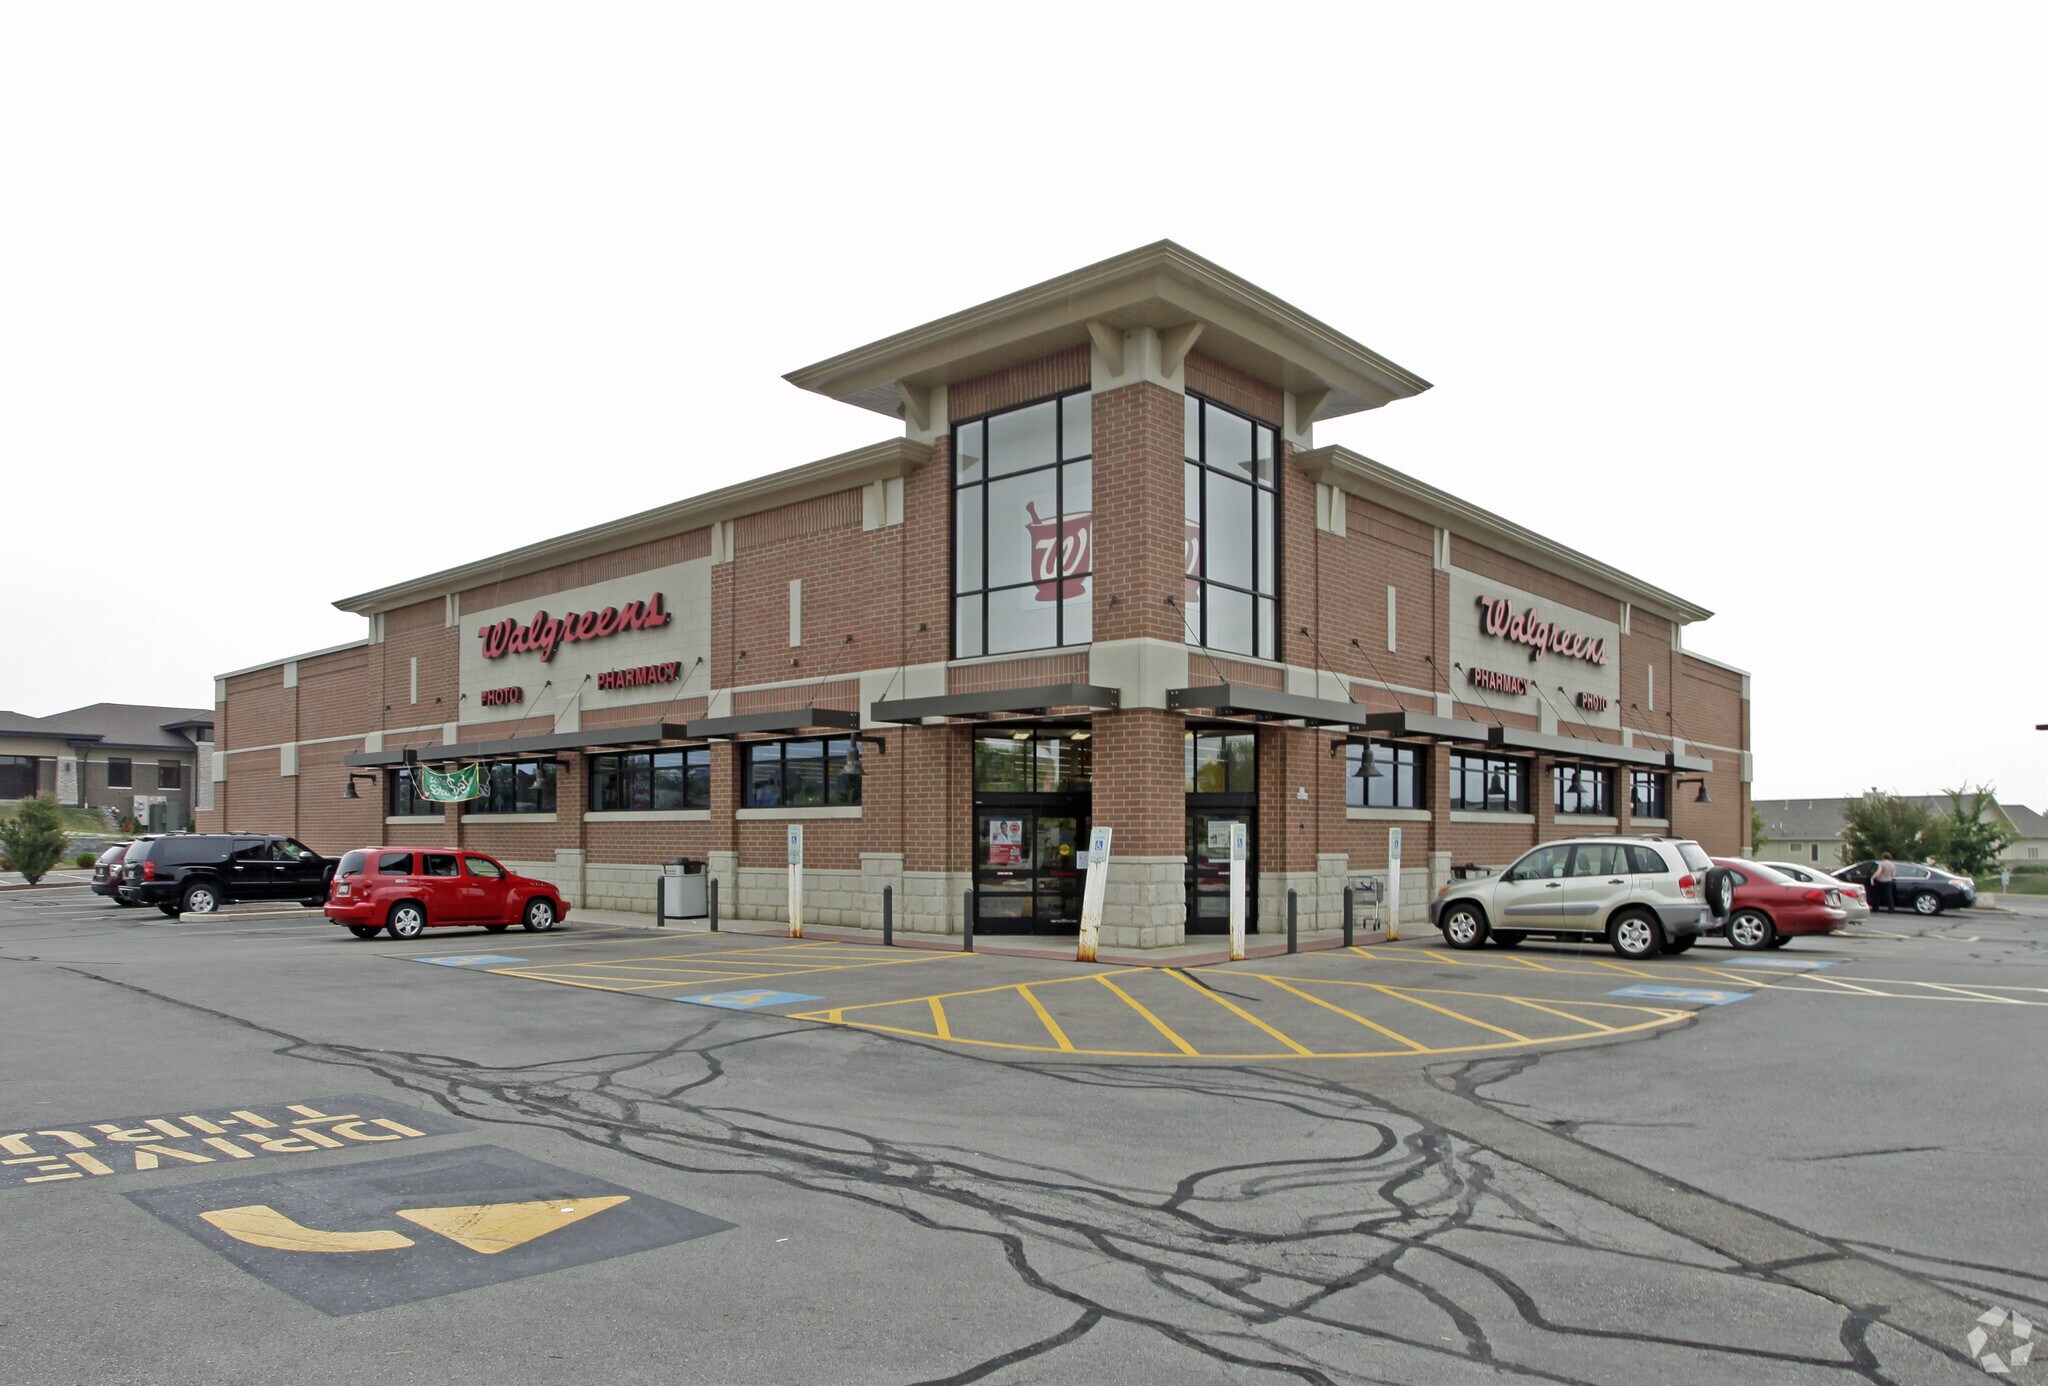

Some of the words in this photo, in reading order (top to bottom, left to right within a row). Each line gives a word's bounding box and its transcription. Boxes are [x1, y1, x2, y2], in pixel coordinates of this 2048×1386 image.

[478, 592, 672, 663] Walgreens
[1479, 595, 1611, 666] Walgreens
[481, 686, 524, 707] PHOTO
[597, 661, 682, 691] PHARMACY
[1472, 667, 1531, 696] PHARMACY
[1581, 692, 1608, 712] PHOTO
[0, 1104, 361, 1156] THRU
[2, 1117, 427, 1184] DRIVE
